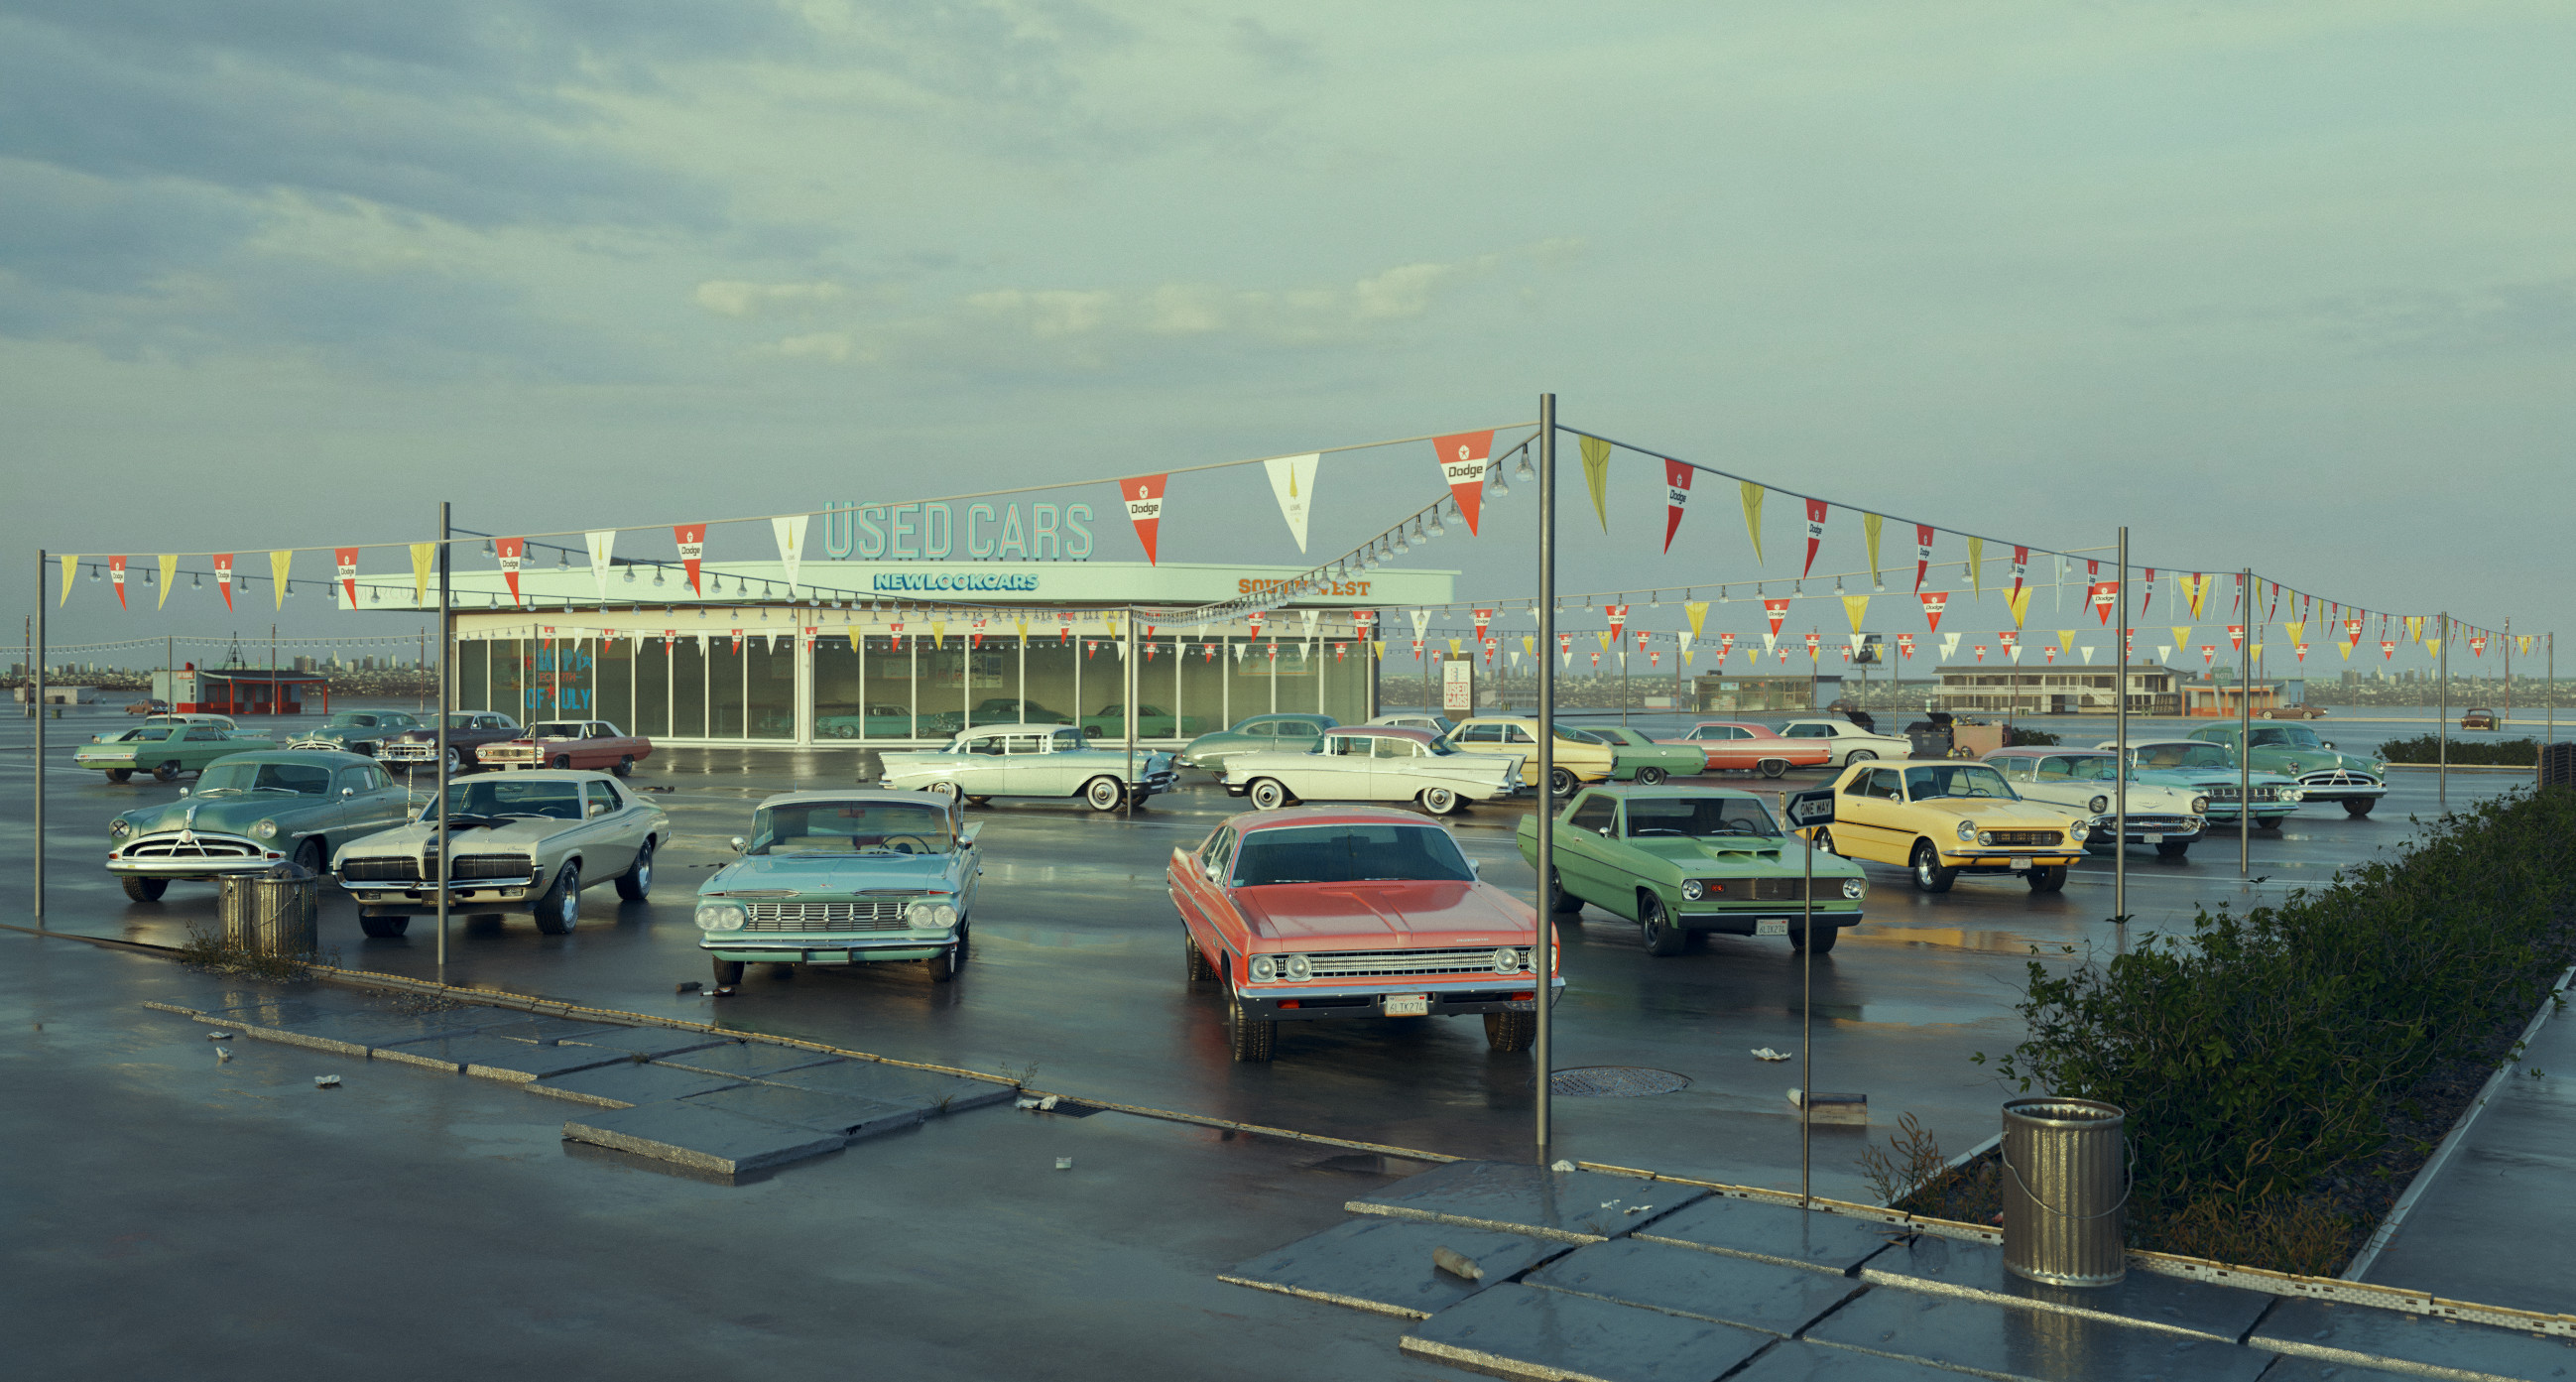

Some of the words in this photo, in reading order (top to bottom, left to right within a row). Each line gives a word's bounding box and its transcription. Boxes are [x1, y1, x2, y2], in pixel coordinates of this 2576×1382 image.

[1448, 463, 1483, 478] Dodge
[1669, 490, 1687, 504] Dodge
[1131, 503, 1160, 515] Dodge
[823, 501, 953, 559] USED
[966, 502, 1094, 559] CARS
[1809, 524, 1822, 536] Dodge
[681, 547, 701, 556] Dodge
[1919, 548, 1930, 559] Dodge
[503, 560, 519, 569] Dodge
[113, 572, 124, 581] Dodge
[218, 571, 230, 580] Dodge
[341, 567, 355, 576] Dodge
[874, 573, 1040, 590] NEWLOOKCARS
[1446, 683, 1468, 694] USED
[526, 688, 545, 708] OF
[1446, 694, 1468, 707] CARS
[1801, 802, 1814, 816] ONE
[1817, 800, 1830, 814] WAY
